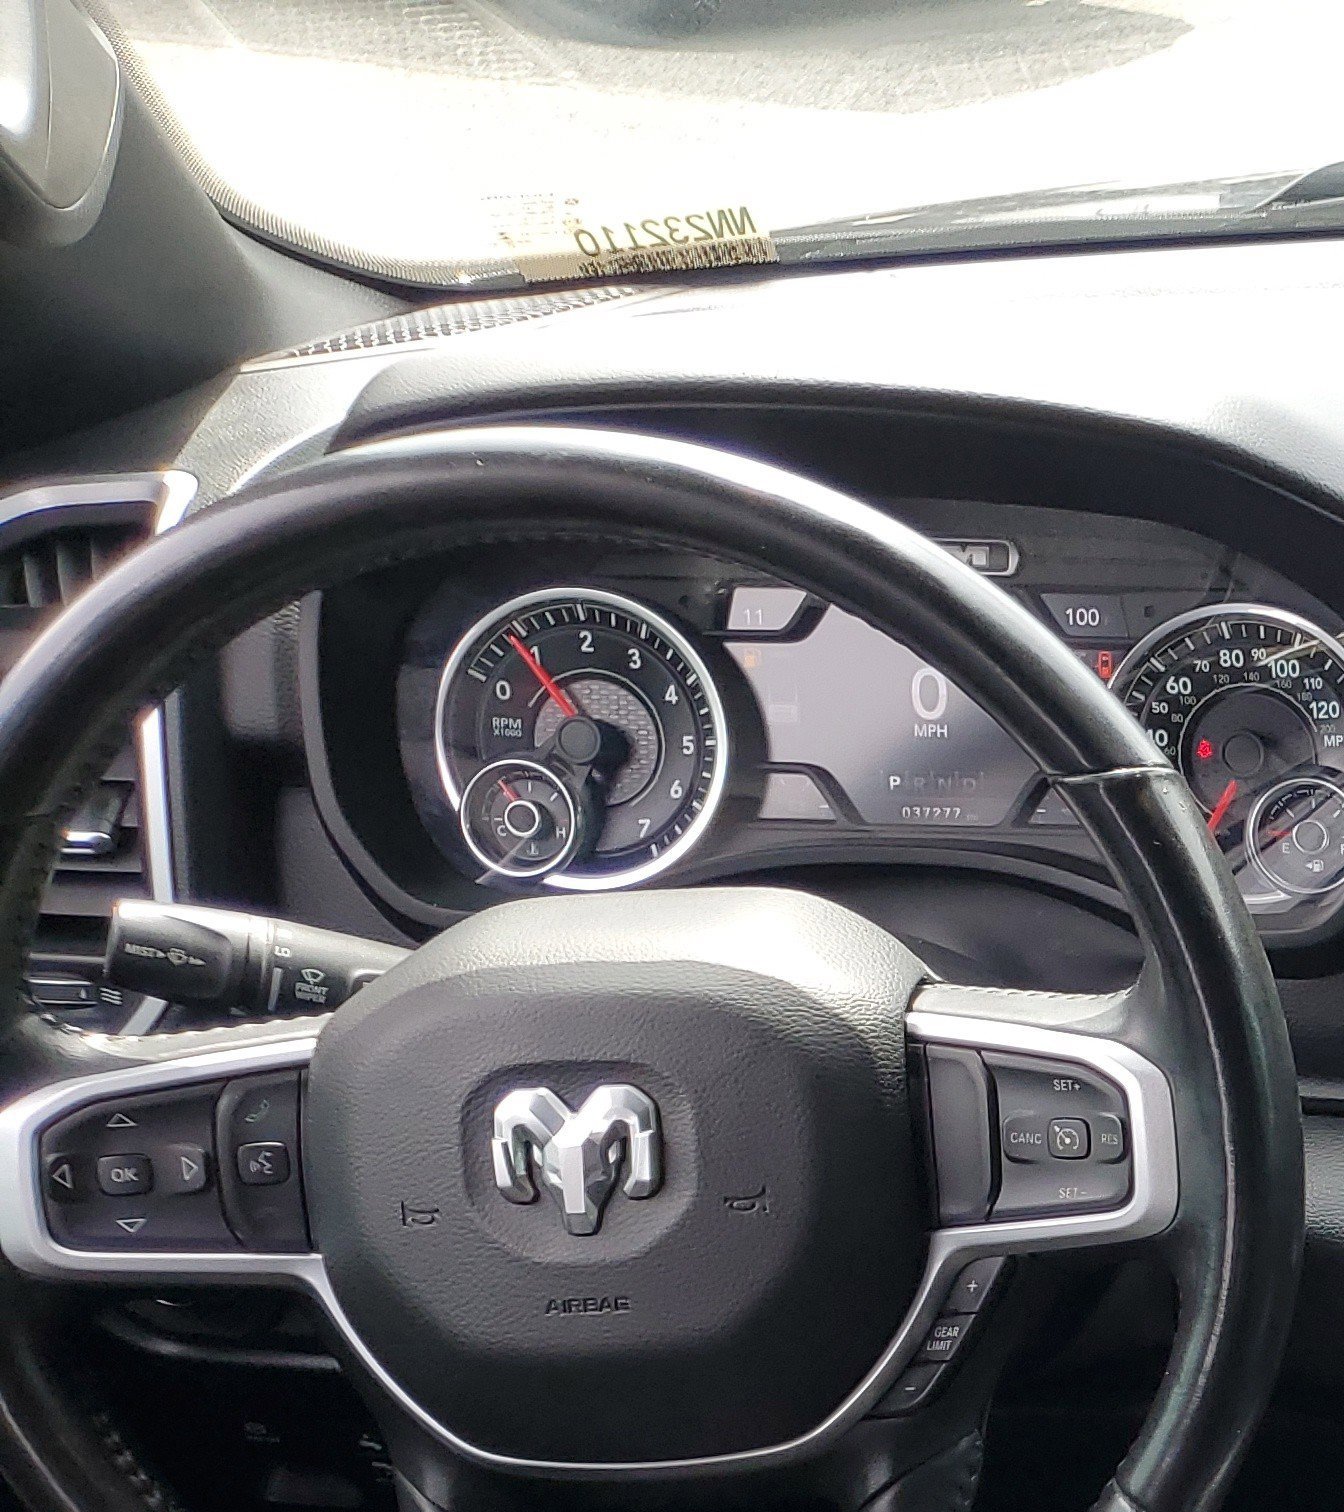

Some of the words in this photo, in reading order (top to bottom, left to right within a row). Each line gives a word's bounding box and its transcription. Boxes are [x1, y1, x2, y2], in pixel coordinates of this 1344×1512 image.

[1065, 608, 1100, 627] 100
[579, 630, 595, 653] 2
[628, 649, 643, 670] 3
[1219, 649, 1244, 668] 80
[1251, 648, 1267, 661] 90
[1194, 660, 1210, 673] 70
[1269, 660, 1300, 679] 100
[496, 680, 511, 700] 0
[1166, 675, 1192, 695] 60
[1303, 676, 1323, 691] 110
[664, 684, 678, 704] 4
[911, 667, 947, 720] 0
[1151, 701, 1169, 714] 50
[1308, 701, 1340, 719] 120
[492, 717, 522, 729] RPM
[914, 724, 948, 738] MPH
[682, 735, 694, 755] 5
[669, 780, 683, 799] 6
[638, 819, 650, 838] 7
[1282, 842, 1290, 854] E
[111, 1168, 138, 1182] OK
[934, 1326, 959, 1338] GEAR
